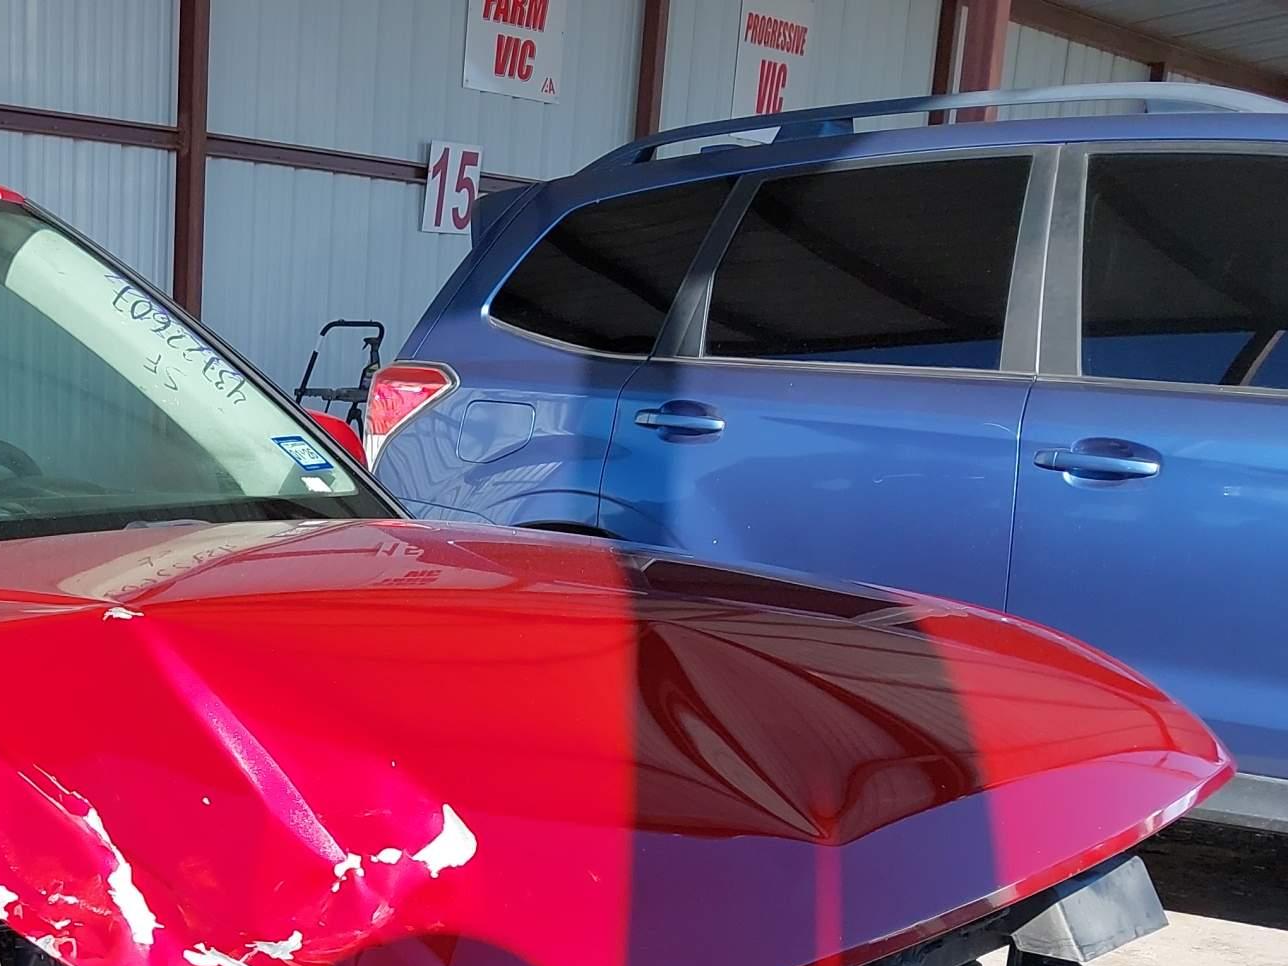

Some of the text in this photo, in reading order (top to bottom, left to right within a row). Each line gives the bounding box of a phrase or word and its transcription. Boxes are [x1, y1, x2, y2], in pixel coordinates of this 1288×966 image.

[494, 33, 536, 81] VIC
[744, 12, 808, 56] PROGRESSIVE
[756, 59, 788, 115] VIC
[432, 147, 479, 230] 15
